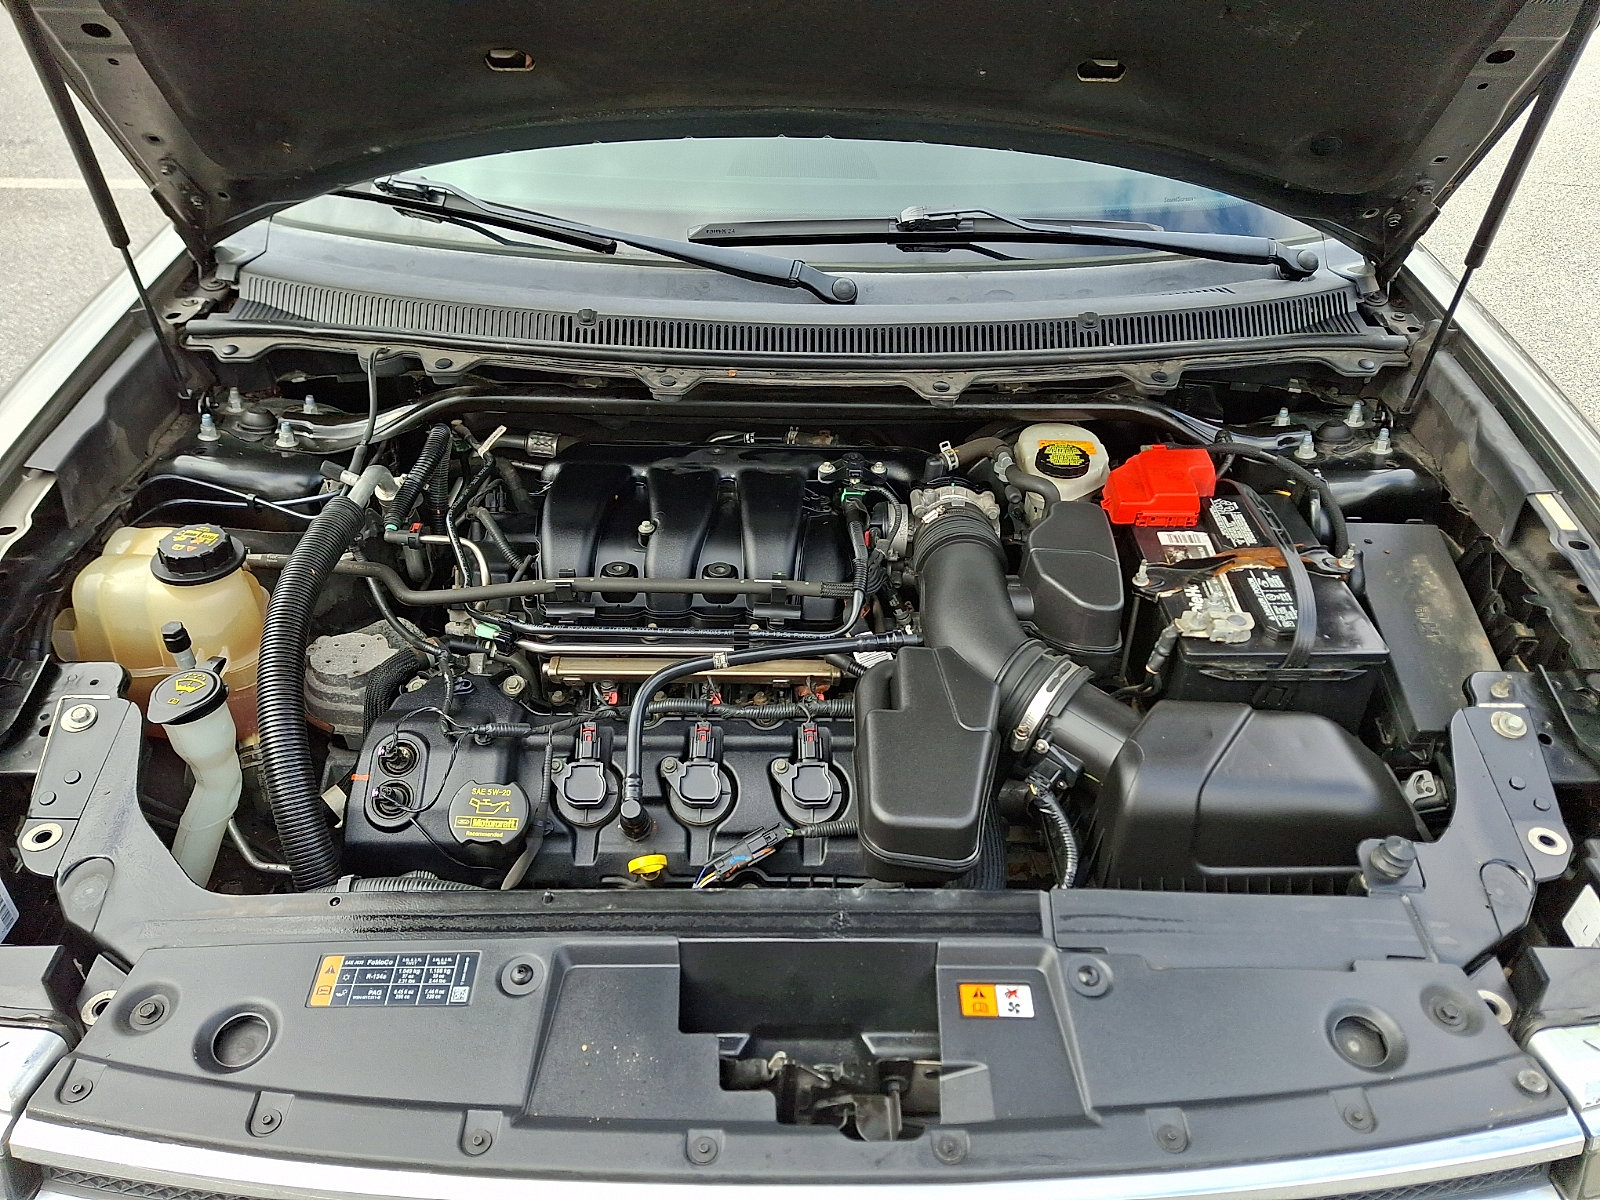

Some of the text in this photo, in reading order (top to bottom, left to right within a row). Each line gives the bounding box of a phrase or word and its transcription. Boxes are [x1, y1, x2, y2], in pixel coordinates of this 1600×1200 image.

[471, 787, 512, 796] SAE 5W-20
[472, 818, 515, 829] Motorcraft
